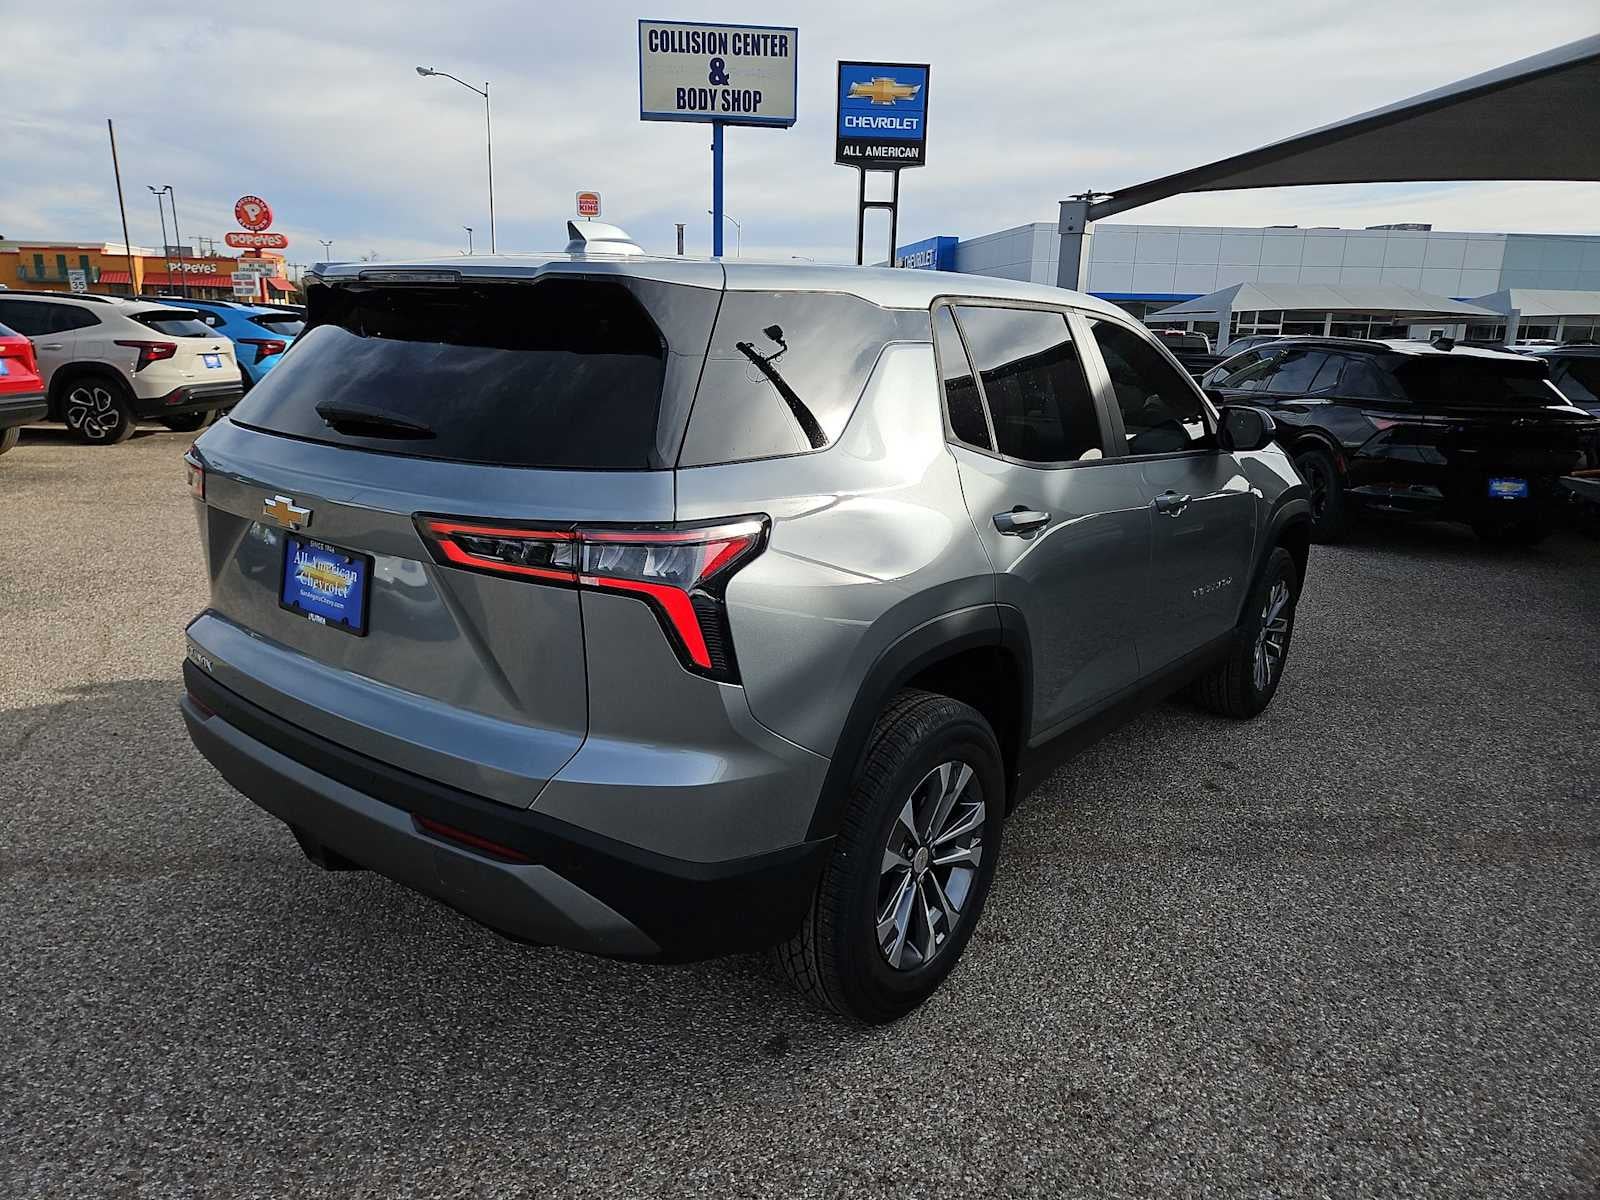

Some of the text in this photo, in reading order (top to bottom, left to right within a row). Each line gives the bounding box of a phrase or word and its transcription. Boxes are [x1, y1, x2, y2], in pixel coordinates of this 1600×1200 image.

[648, 29, 788, 57] COLLISION CENTER
[708, 57, 730, 86] &
[676, 87, 762, 113] BODY SHOP
[844, 115, 919, 130] CHEVROLET
[842, 145, 919, 158] ALL AMERICAN
[579, 204, 599, 212] KING
[71, 281, 85, 290] 35
[293, 551, 358, 583] All American
[300, 571, 349, 599] Chevrolet
